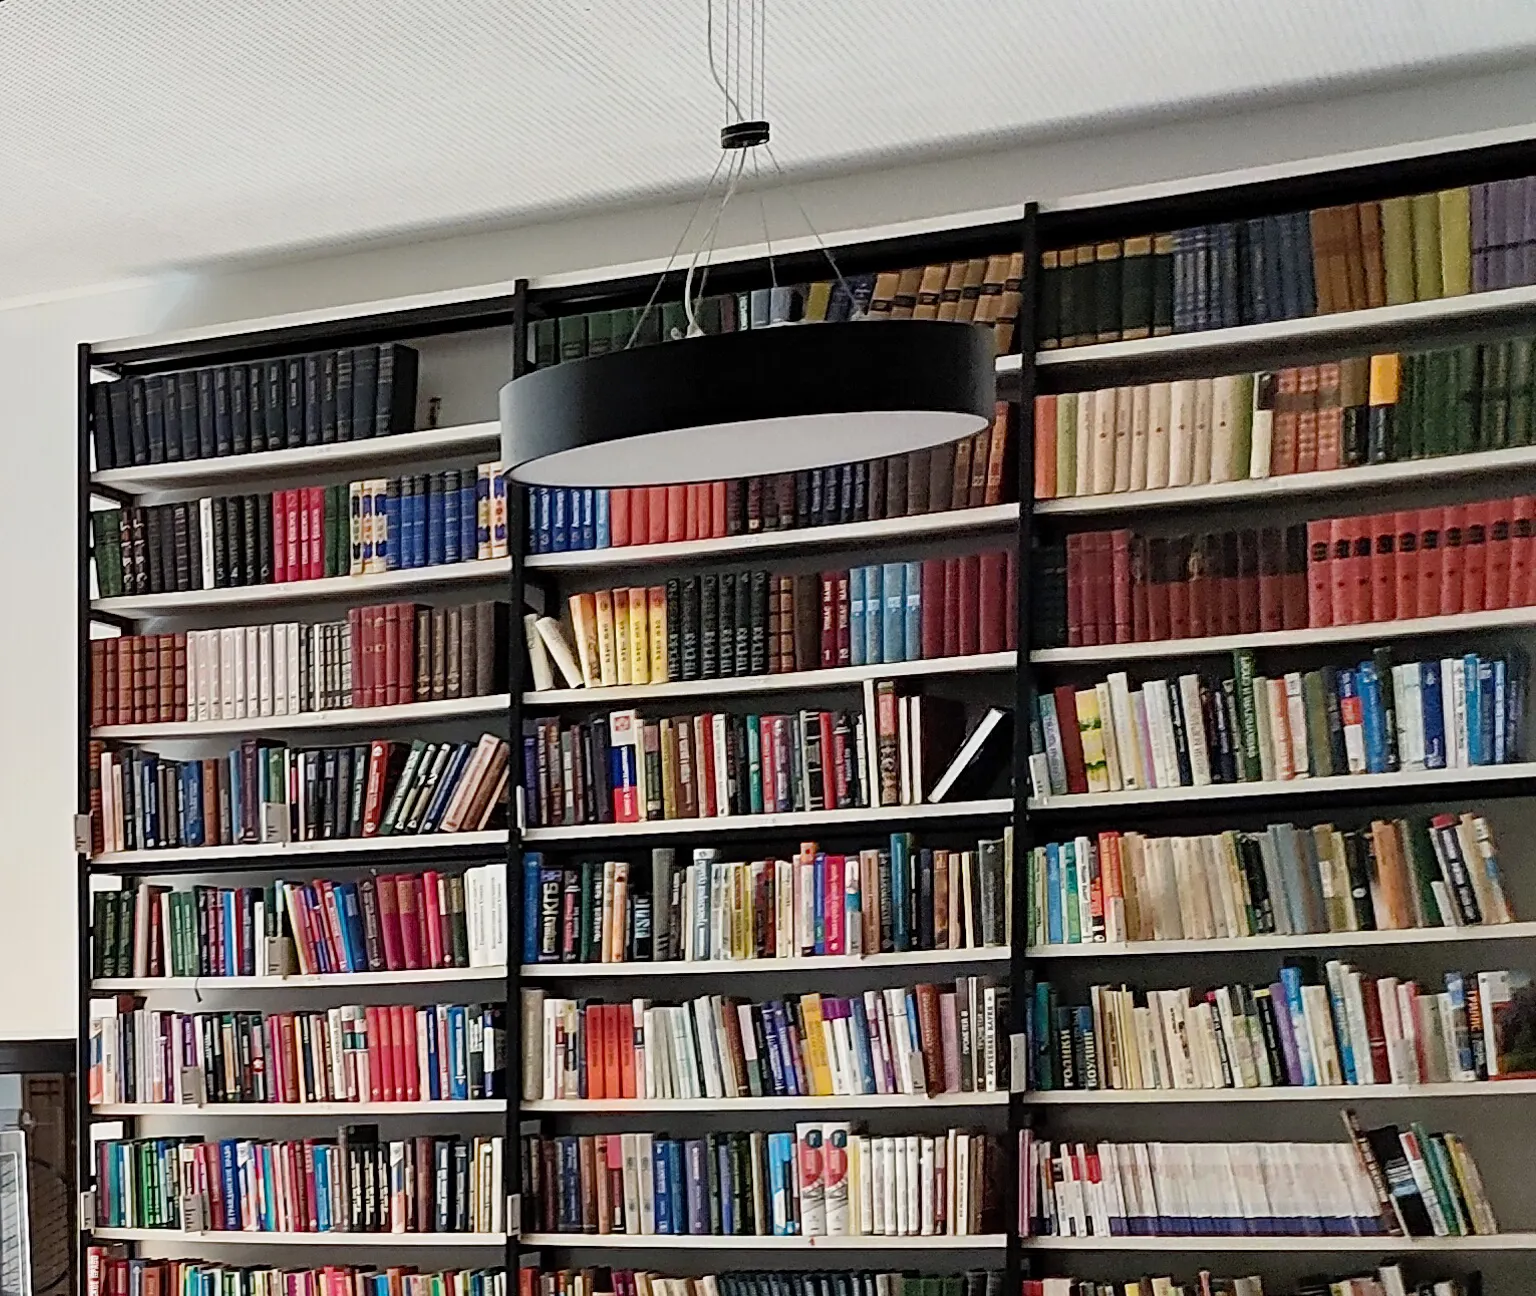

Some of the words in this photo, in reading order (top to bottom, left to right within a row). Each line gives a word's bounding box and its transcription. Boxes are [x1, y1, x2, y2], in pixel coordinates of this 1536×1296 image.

[826, 650, 830, 660] 1
[839, 648, 848, 658] 2
[542, 883, 559, 915] КГБ
[1083, 1030, 1097, 1087] БОУЛИНГ
